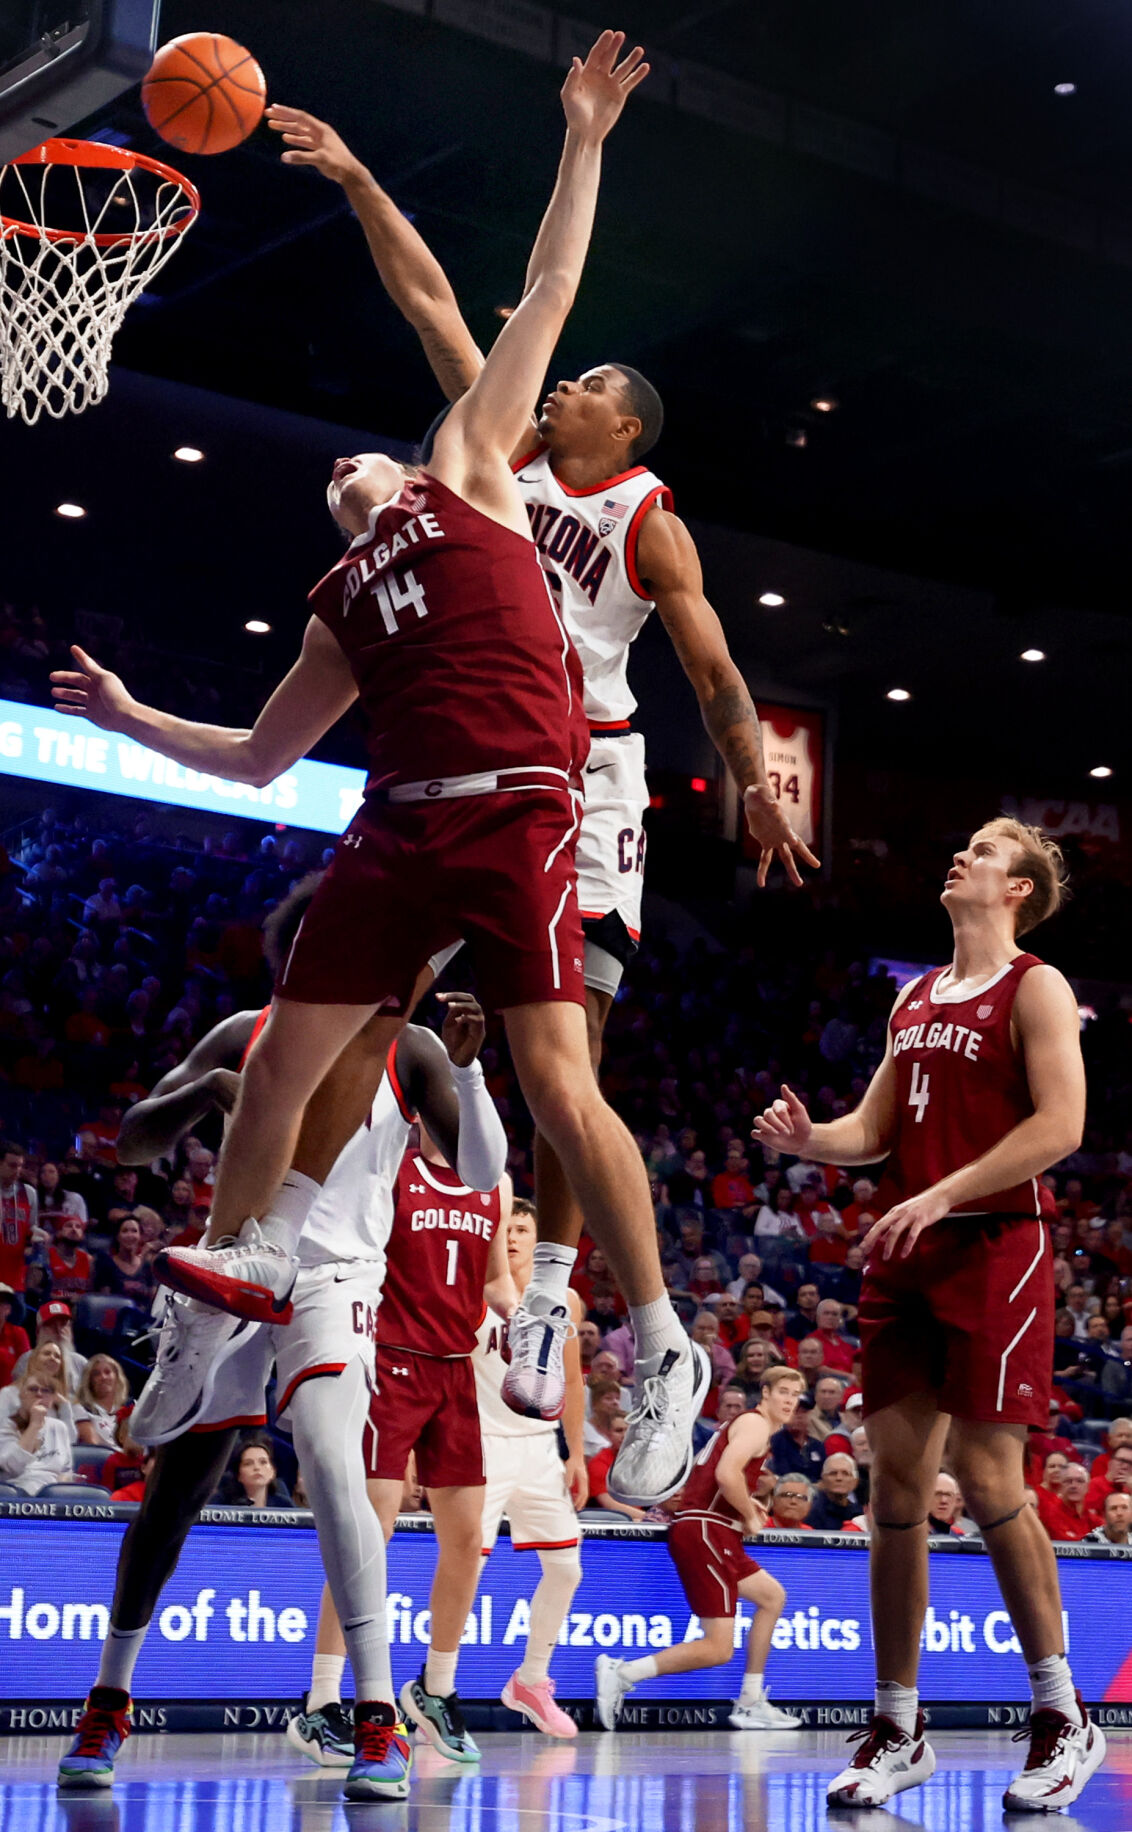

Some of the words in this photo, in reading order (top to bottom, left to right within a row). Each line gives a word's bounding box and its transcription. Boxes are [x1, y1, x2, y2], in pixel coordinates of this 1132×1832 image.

[343, 513, 446, 617] COLGATE
[525, 503, 612, 607] IZONA
[370, 570, 429, 635] 14
[34, 727, 108, 774] THE
[769, 751, 797, 765] SIMON
[424, 781, 443, 797] C
[768, 771, 800, 804] 34
[893, 1022, 984, 1062] COLGATE
[908, 1062, 930, 1123] 4
[411, 1208, 494, 1241] COLGATE
[446, 1240, 459, 1286] 1
[352, 1301, 376, 1342] CA
[8, 1502, 57, 1516] HOME
[65, 1504, 116, 1518] LOANS
[200, 1510, 245, 1523] HOME
[251, 1511, 299, 1525] LOANS
[613, 1528, 654, 1538] LOANS
[763, 1533, 801, 1544] LOANS
[1056, 1546, 1090, 1557] LOANS
[0, 1587, 110, 1640] Hom
[159, 1588, 216, 1641] of
[226, 1590, 308, 1642] the
[10, 1708, 81, 1728] HOME
[659, 1707, 717, 1724] LOANS
[817, 1707, 868, 1724] HOME
